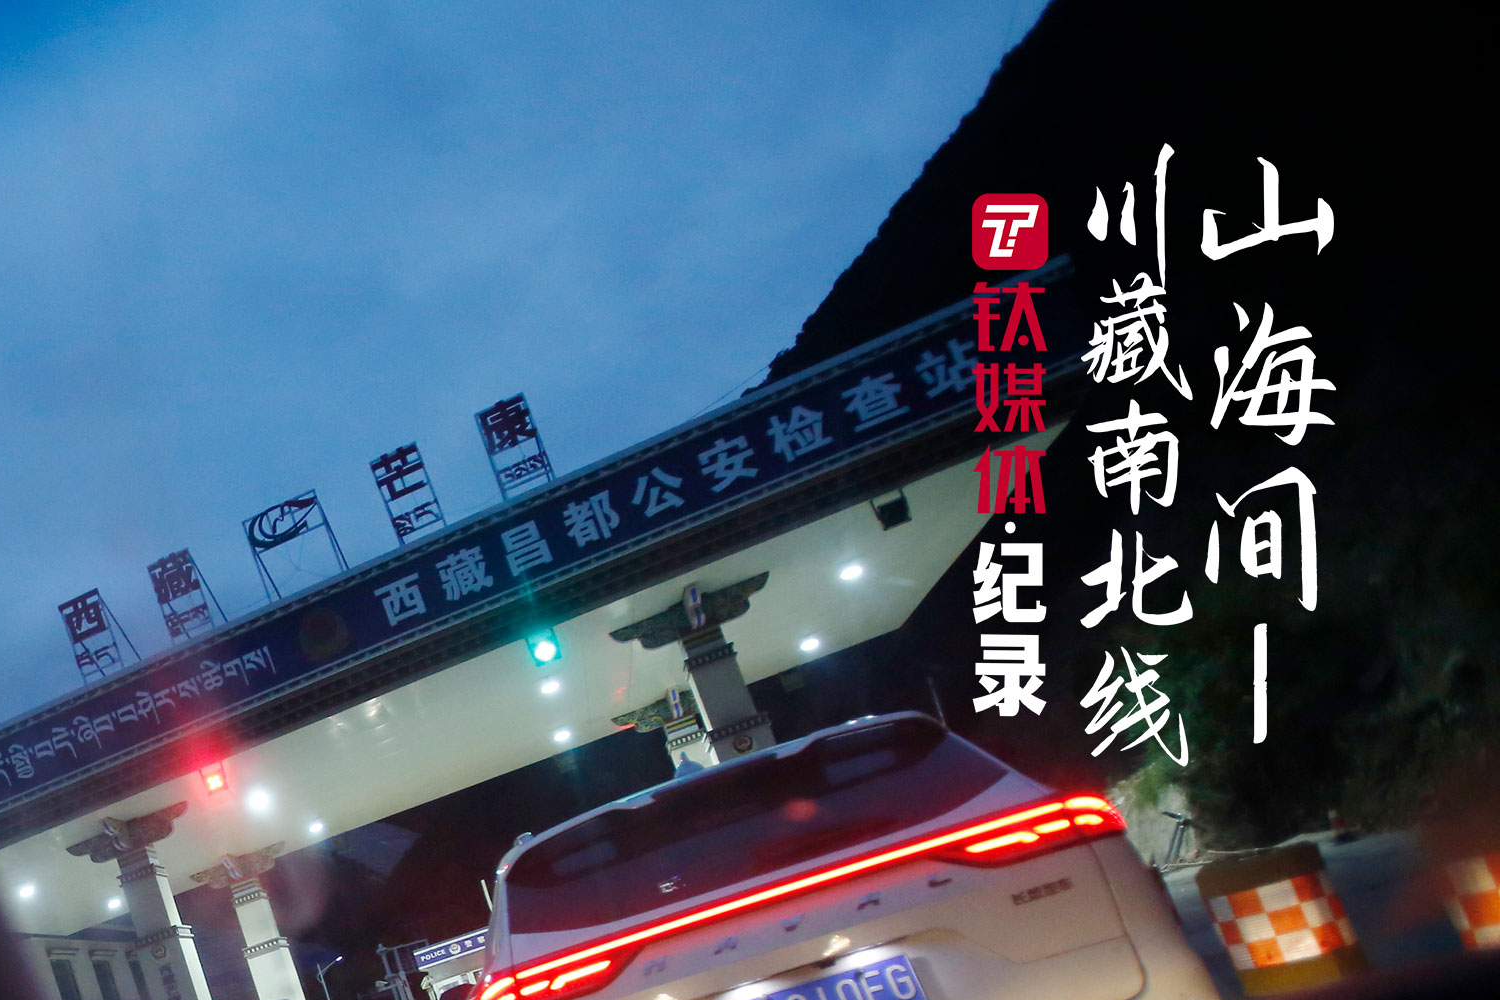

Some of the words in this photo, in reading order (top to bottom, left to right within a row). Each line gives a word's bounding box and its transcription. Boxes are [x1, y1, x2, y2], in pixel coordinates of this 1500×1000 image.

[373, 338, 979, 628] 西藏昌都公安检查站
[419, 949, 446, 963] POLICE
